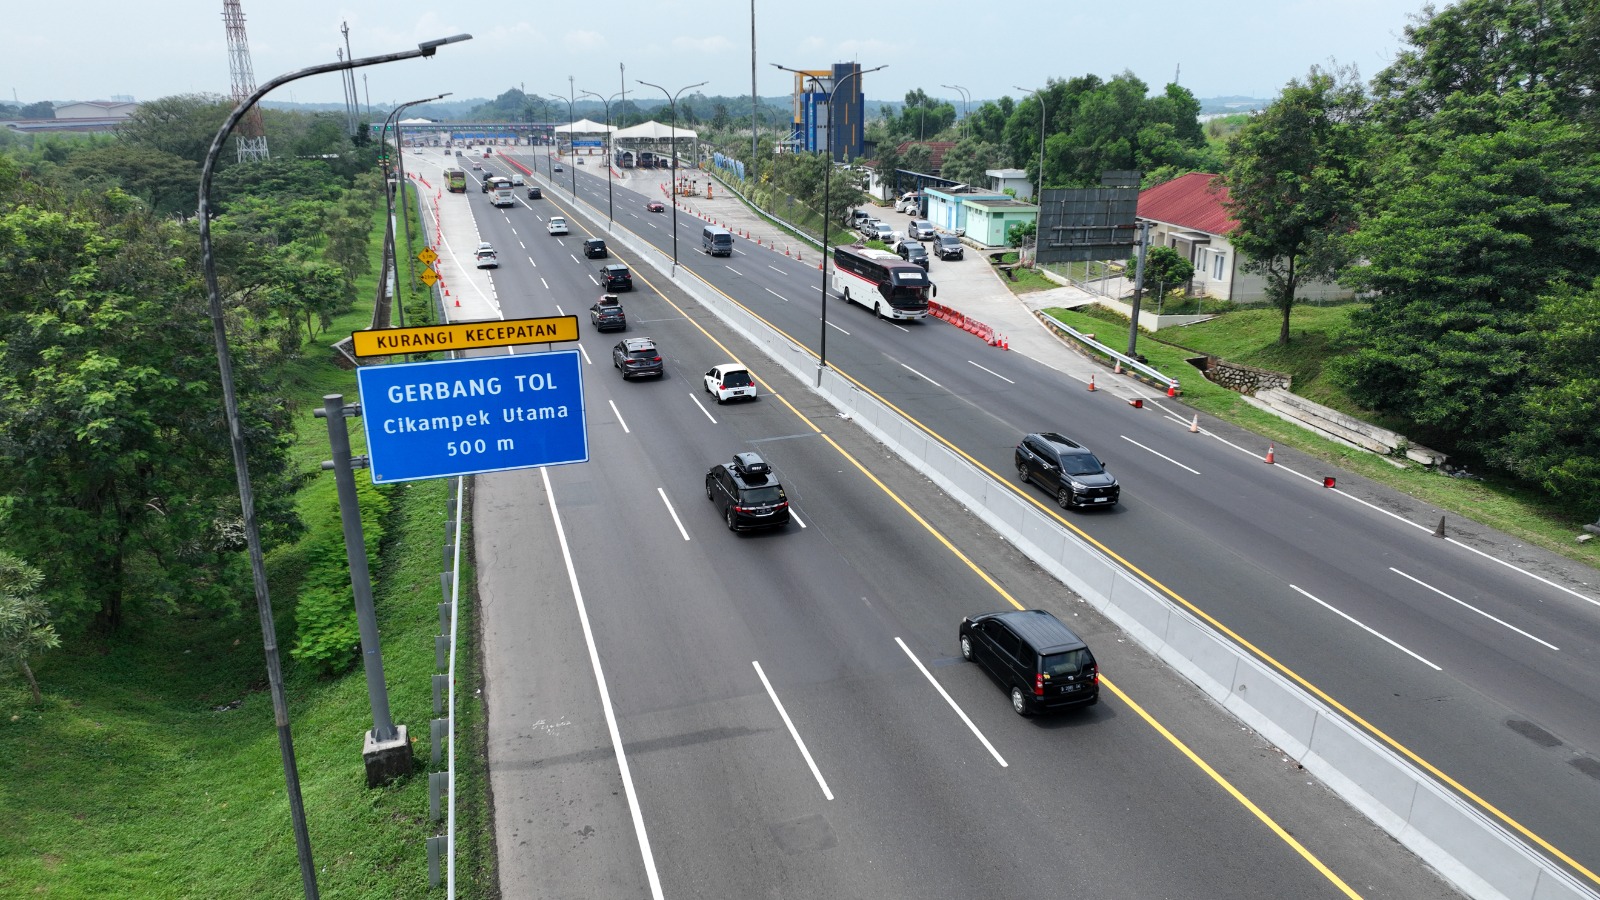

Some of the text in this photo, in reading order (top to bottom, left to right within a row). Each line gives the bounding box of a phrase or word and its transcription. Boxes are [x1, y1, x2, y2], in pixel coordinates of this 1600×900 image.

[377, 323, 557, 348] KURANGI KECEPATAN
[388, 373, 558, 404] GERBANG TOL
[383, 405, 568, 434] Cikampek Utama
[447, 438, 515, 456] 500 m
